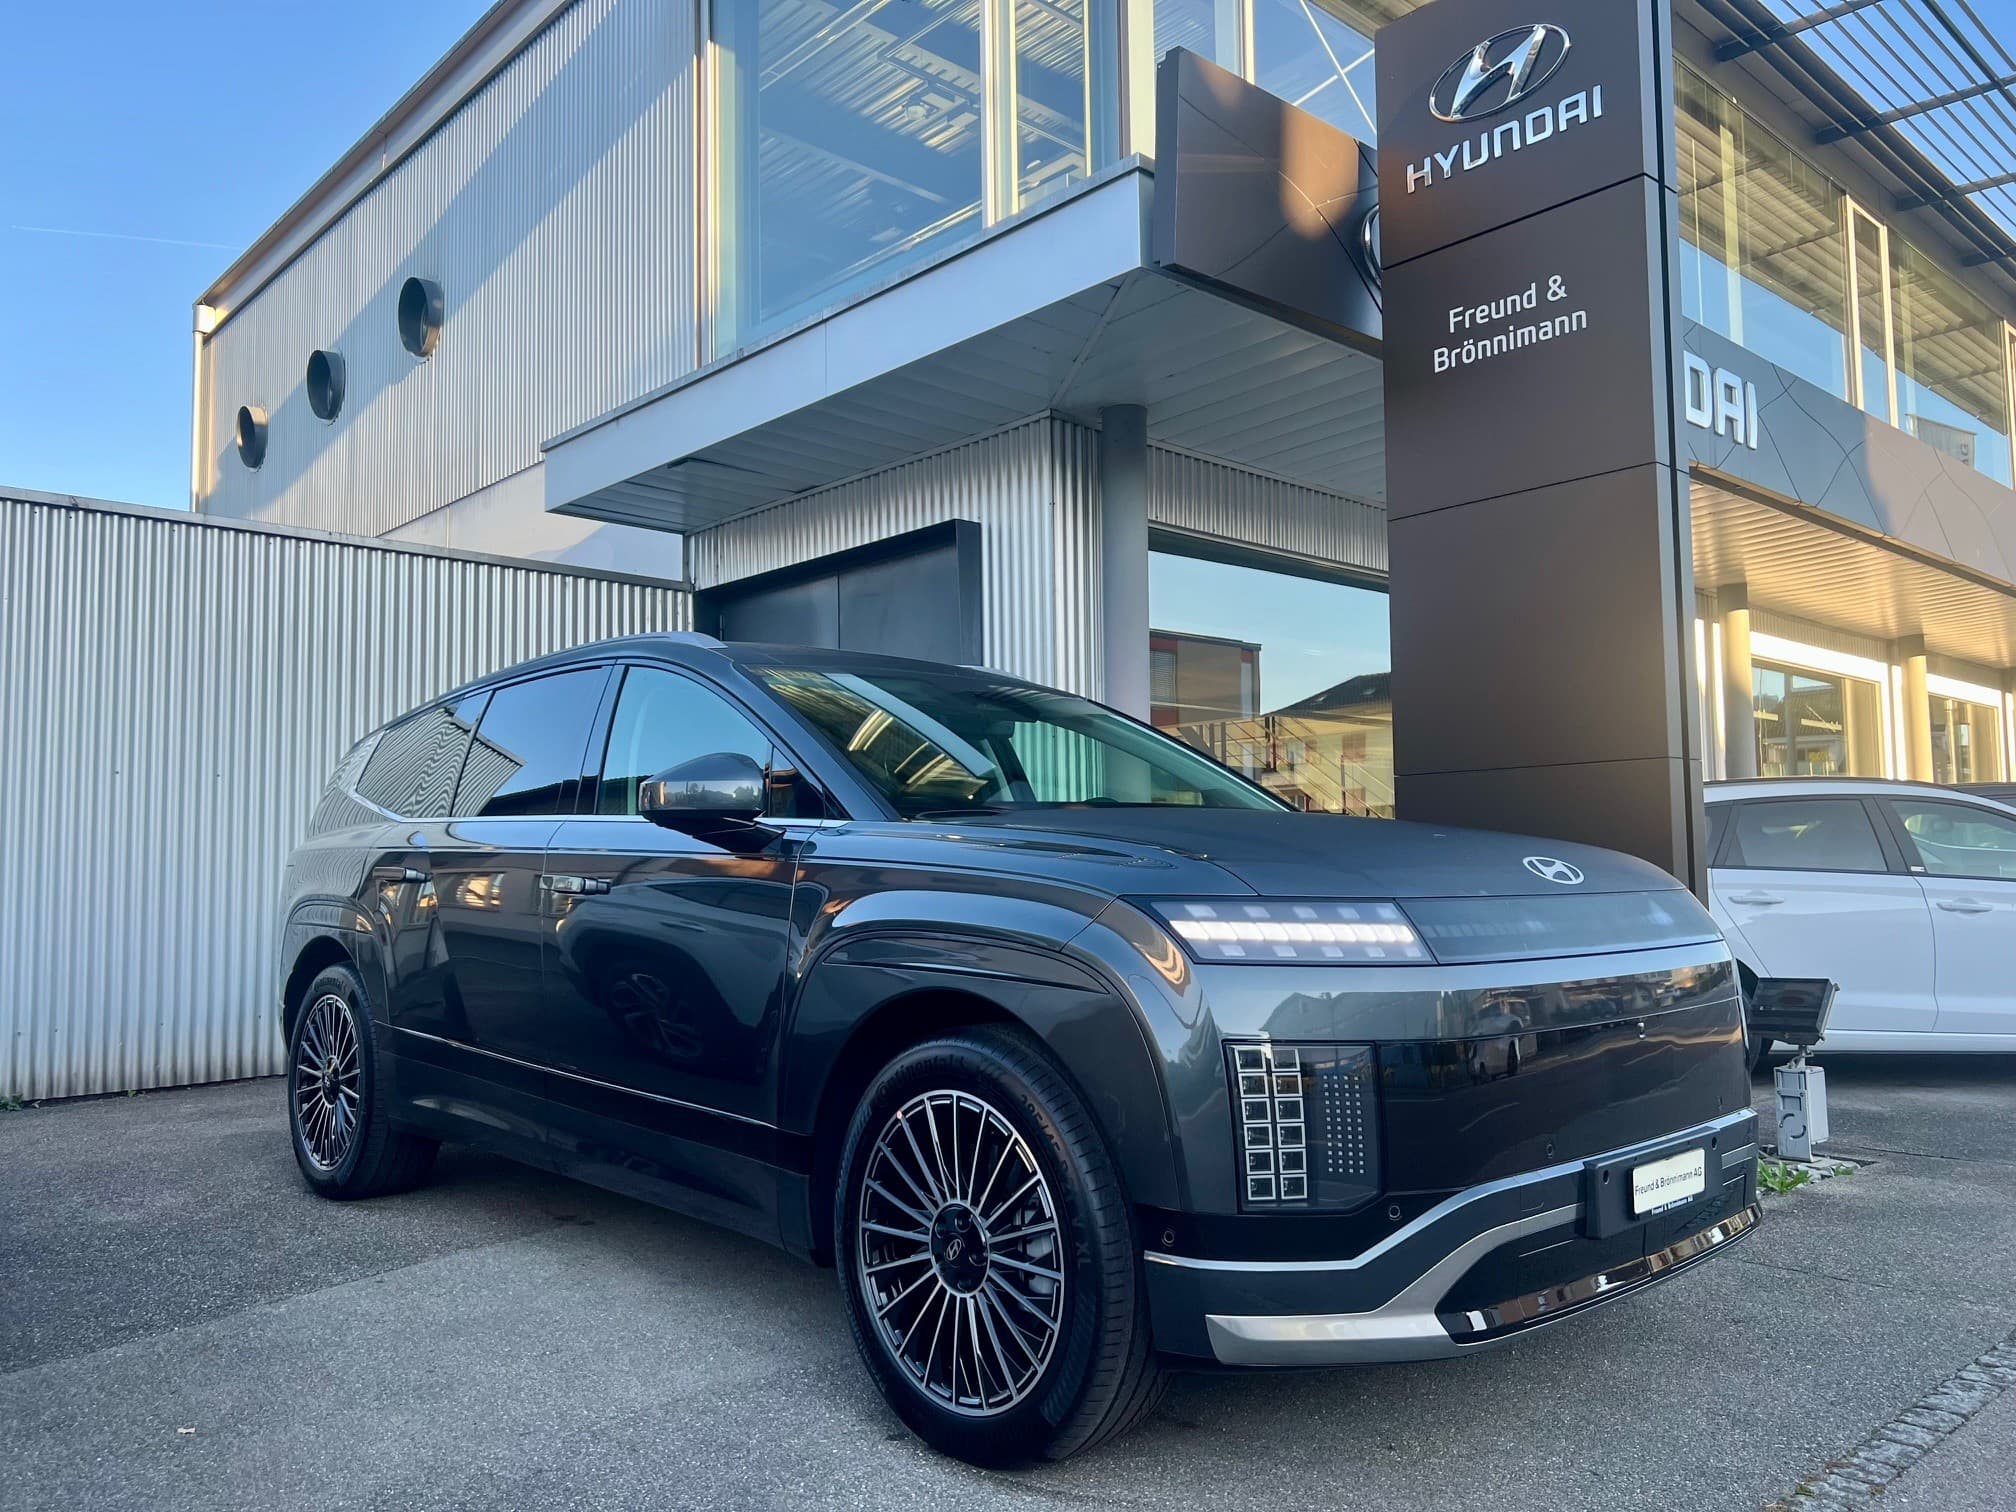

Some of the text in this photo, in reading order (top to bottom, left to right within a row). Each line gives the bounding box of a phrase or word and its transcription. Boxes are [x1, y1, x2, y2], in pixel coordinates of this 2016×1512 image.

[1406, 84, 1603, 194] HYUNDAI
[1449, 274, 1568, 334] Freund &
[1433, 310, 1588, 374] Brönnimann
[1634, 1181, 1655, 1196] Freund
[1655, 1178, 1660, 1190] &
[1693, 1166, 1703, 1177] AG
